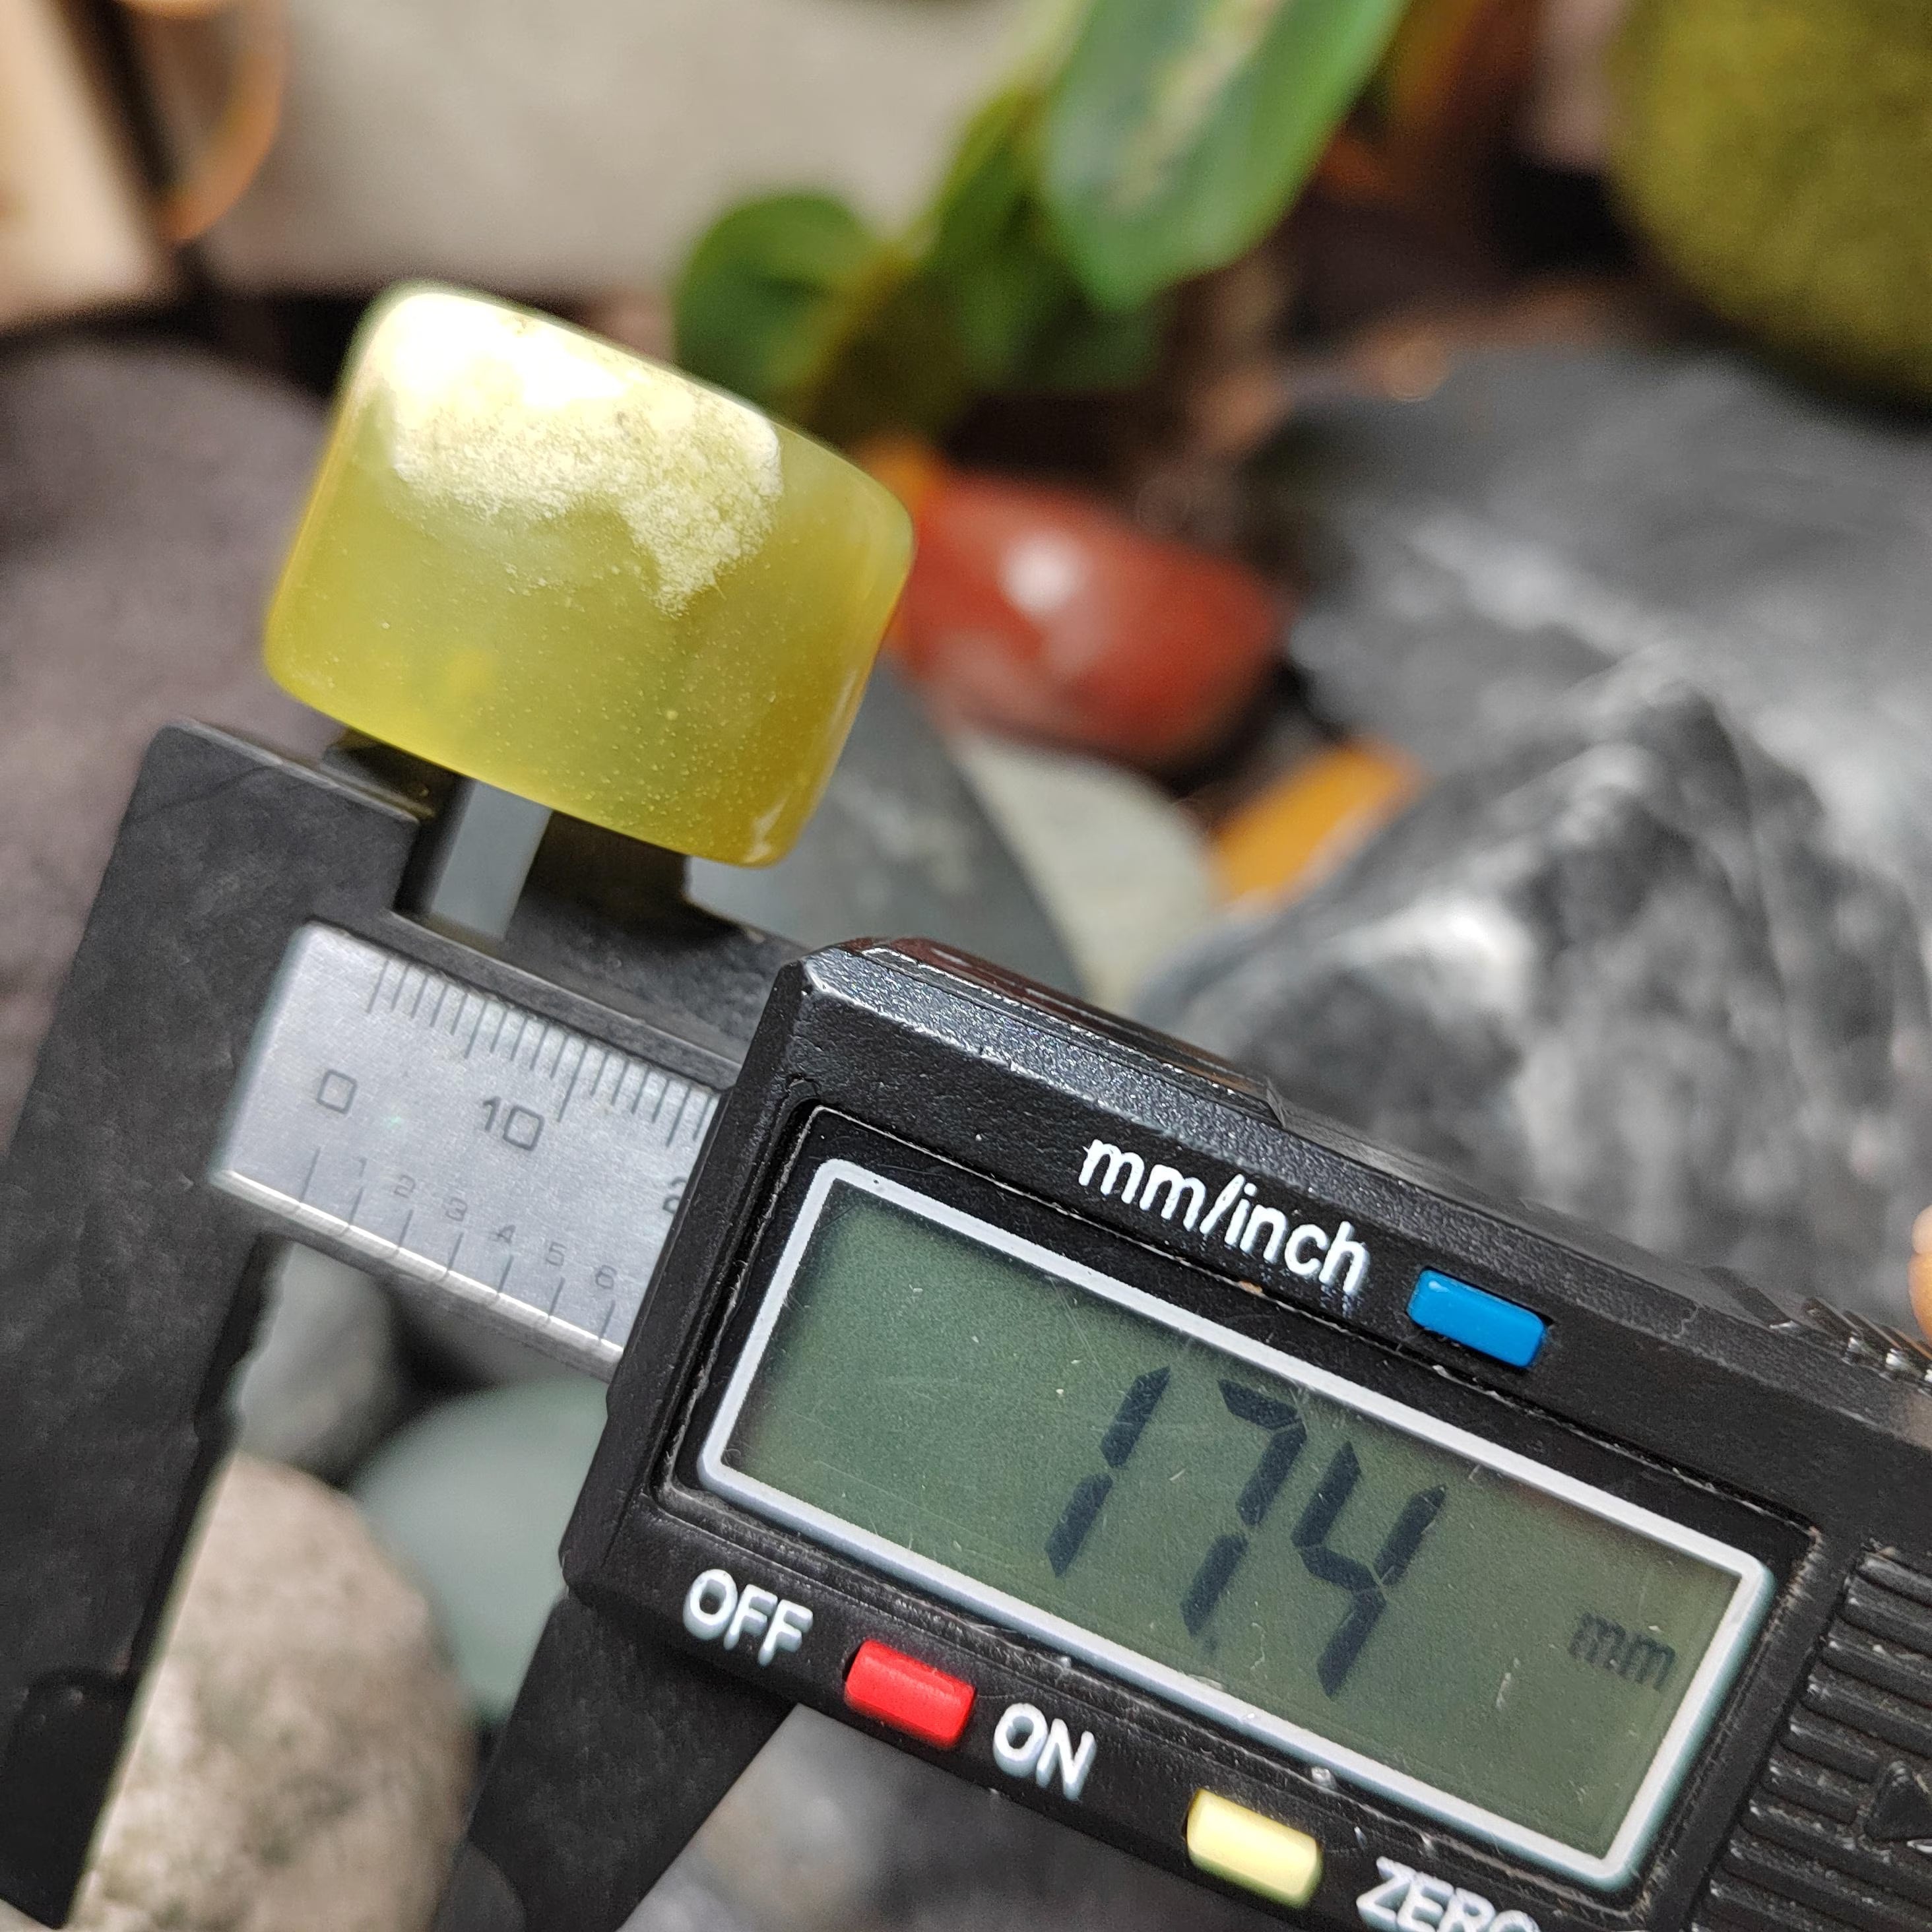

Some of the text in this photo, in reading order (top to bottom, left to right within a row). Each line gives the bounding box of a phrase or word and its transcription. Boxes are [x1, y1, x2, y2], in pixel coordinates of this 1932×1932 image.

[316, 1068, 358, 1114] 0
[482, 1095, 544, 1151] 10
[393, 1174, 417, 1199] 2
[444, 1196, 468, 1222] 3
[495, 1224, 517, 1244] 4
[545, 1241, 567, 1267] 5
[594, 1264, 618, 1290] 6
[1078, 1139, 1369, 1296] mm/inch
[682, 1568, 814, 1667] OFF
[1566, 1610, 1677, 1694] mm
[993, 1702, 1097, 1802] ON
